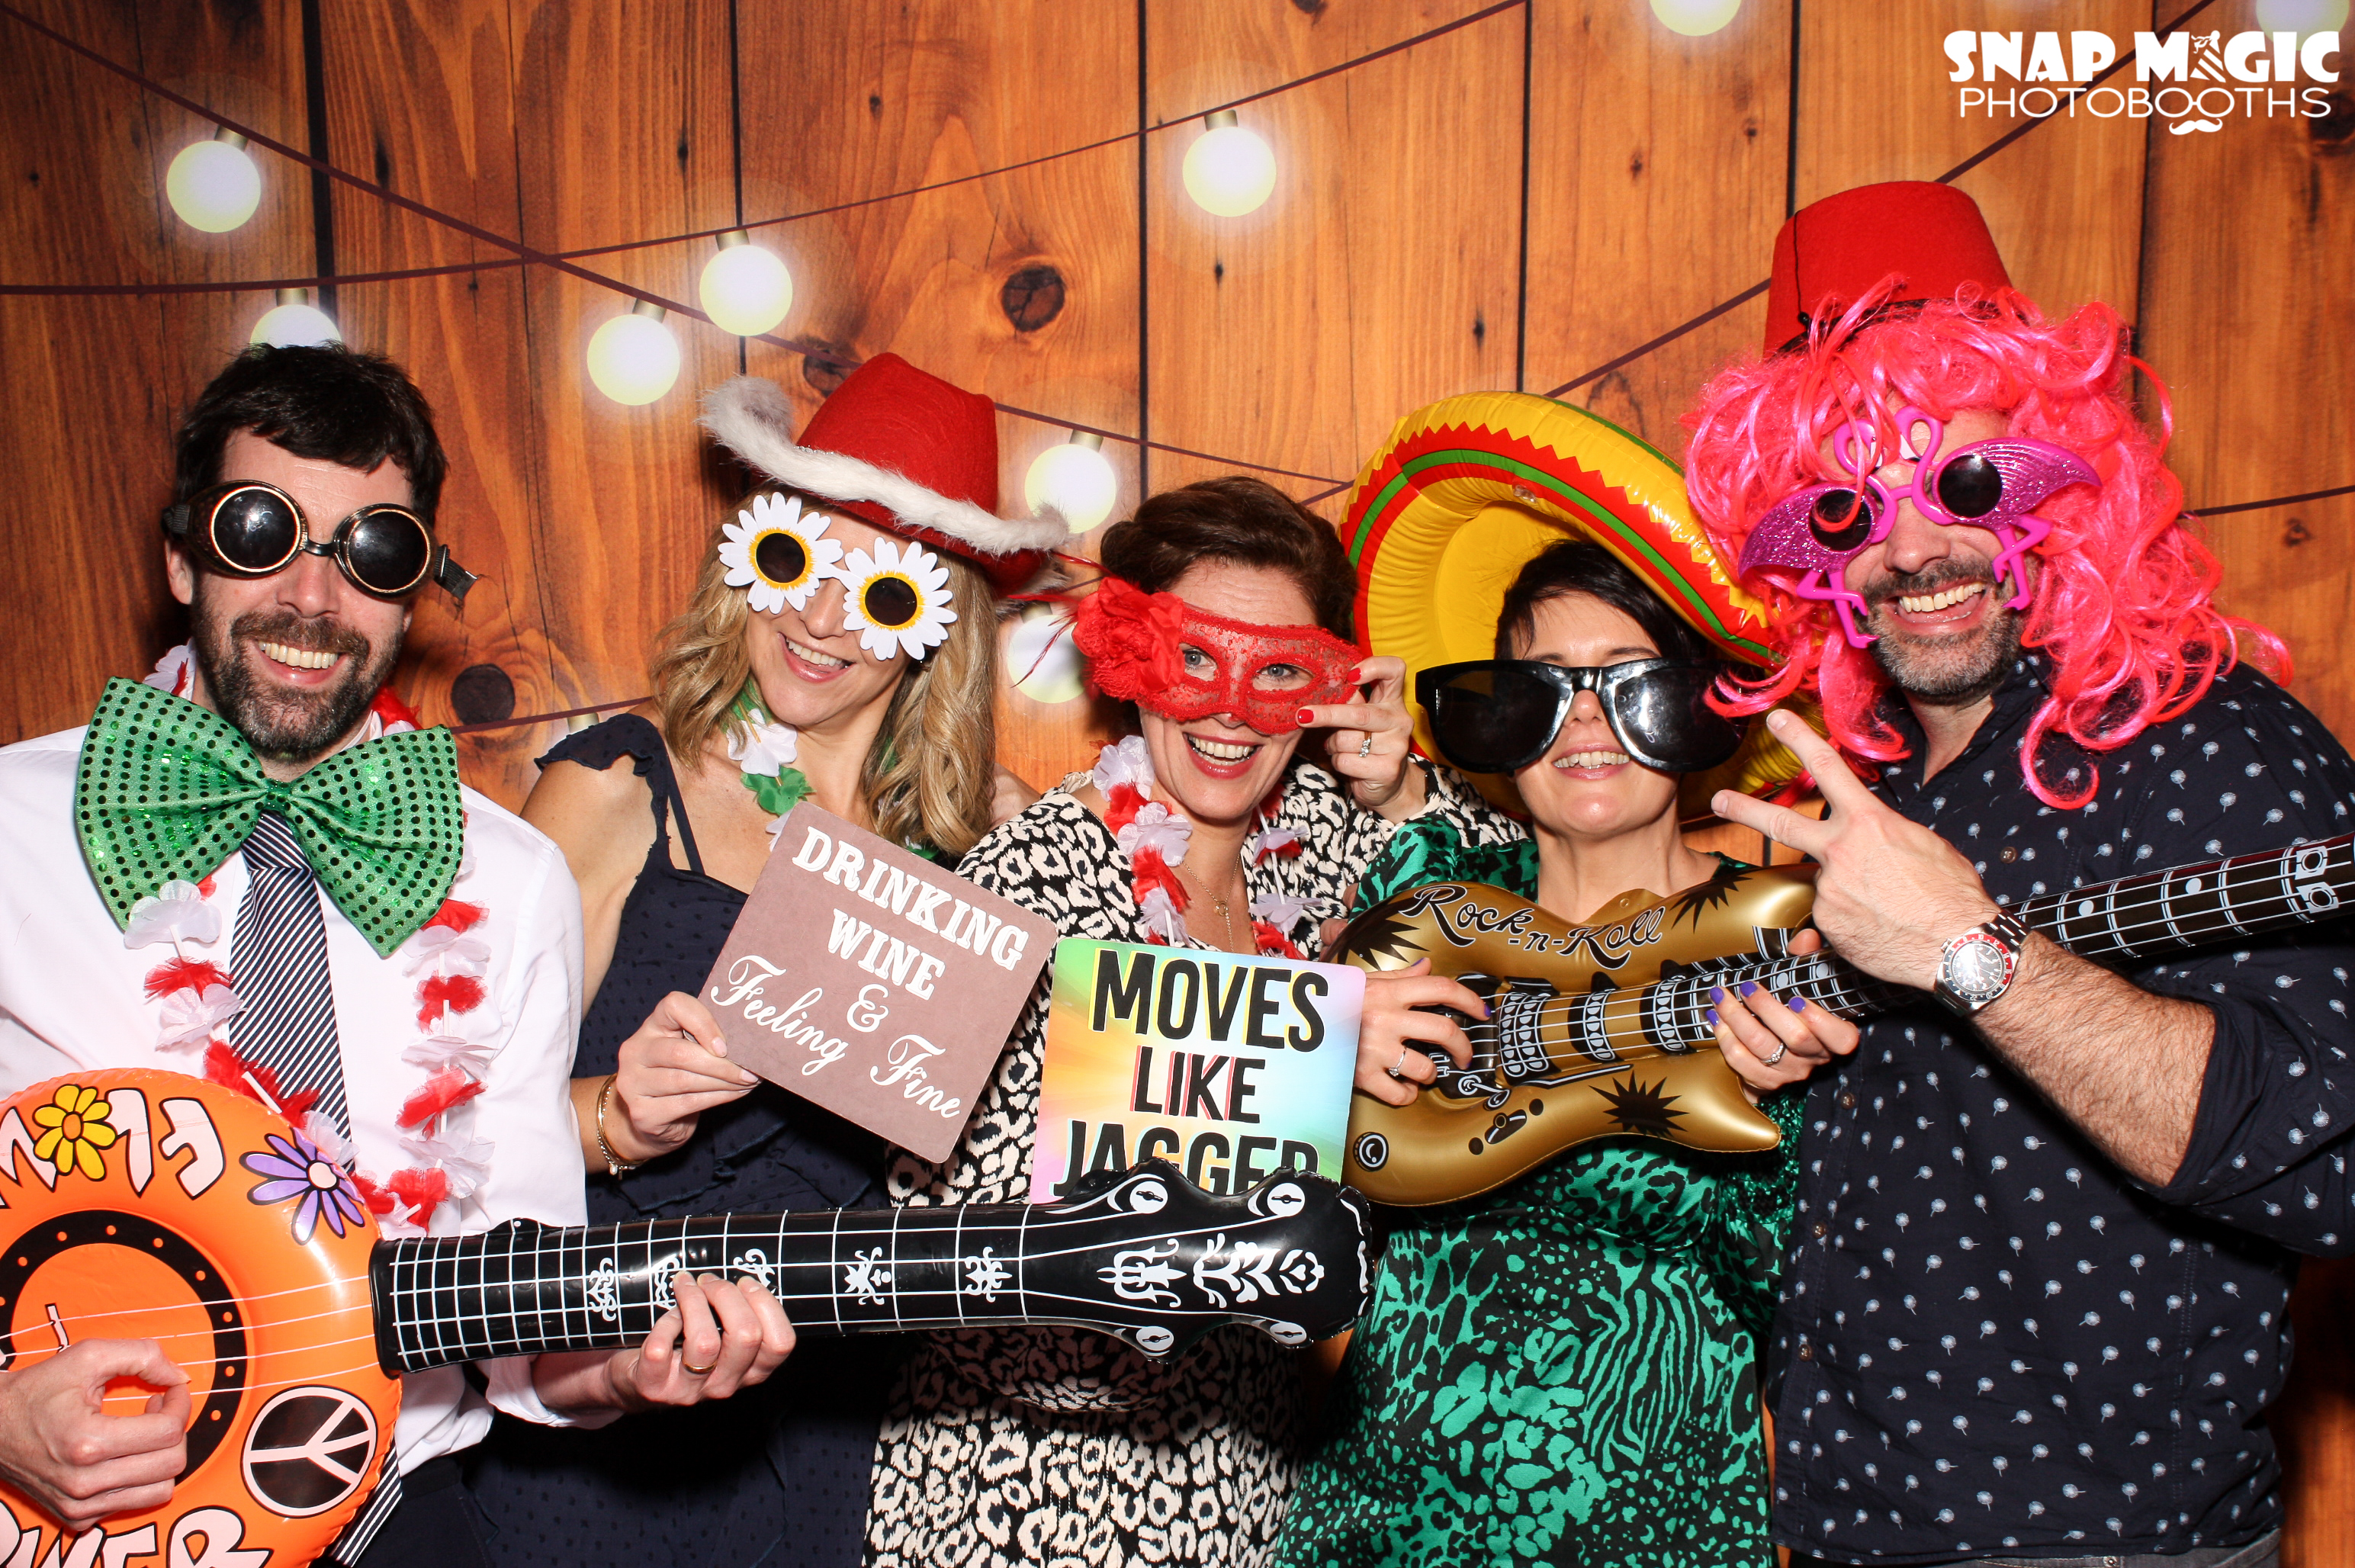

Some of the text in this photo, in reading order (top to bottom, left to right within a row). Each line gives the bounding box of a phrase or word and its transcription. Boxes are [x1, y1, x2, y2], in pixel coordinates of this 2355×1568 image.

[792, 826, 1029, 971] DRINKING
[827, 908, 946, 1001] WINE
[1088, 947, 1329, 1052] MOVES
[710, 954, 961, 1119] Feeling Fine
[847, 983, 890, 1033] &
[1129, 1045, 1266, 1123] LIKE
